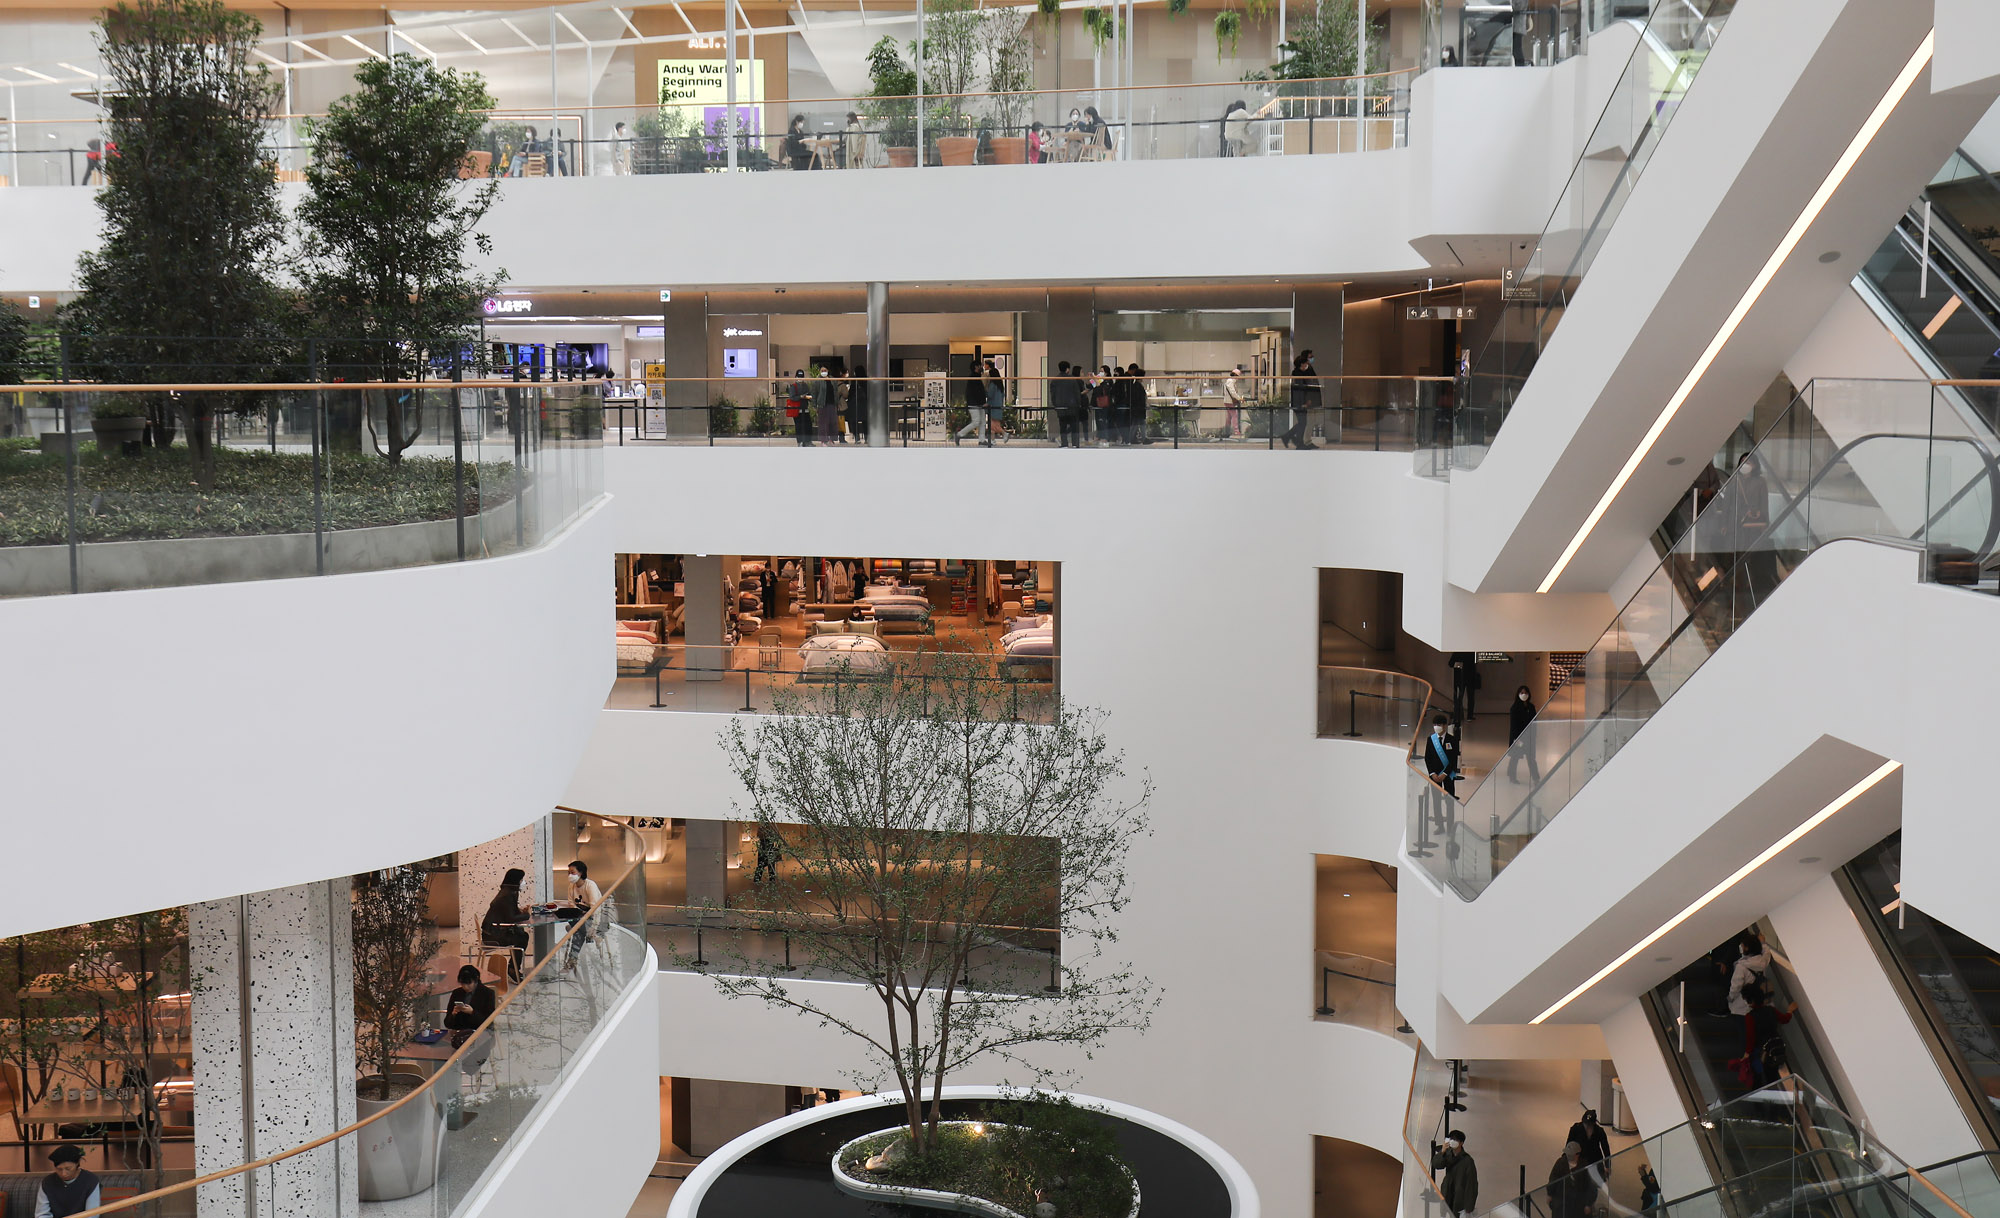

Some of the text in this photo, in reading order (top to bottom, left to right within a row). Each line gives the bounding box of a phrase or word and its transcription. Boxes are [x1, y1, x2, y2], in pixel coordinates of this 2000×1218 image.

[663, 64, 694, 75] Andy
[663, 77, 722, 87] Beginning
[664, 89, 696, 98] Seoul
[1506, 270, 1513, 280] 5
